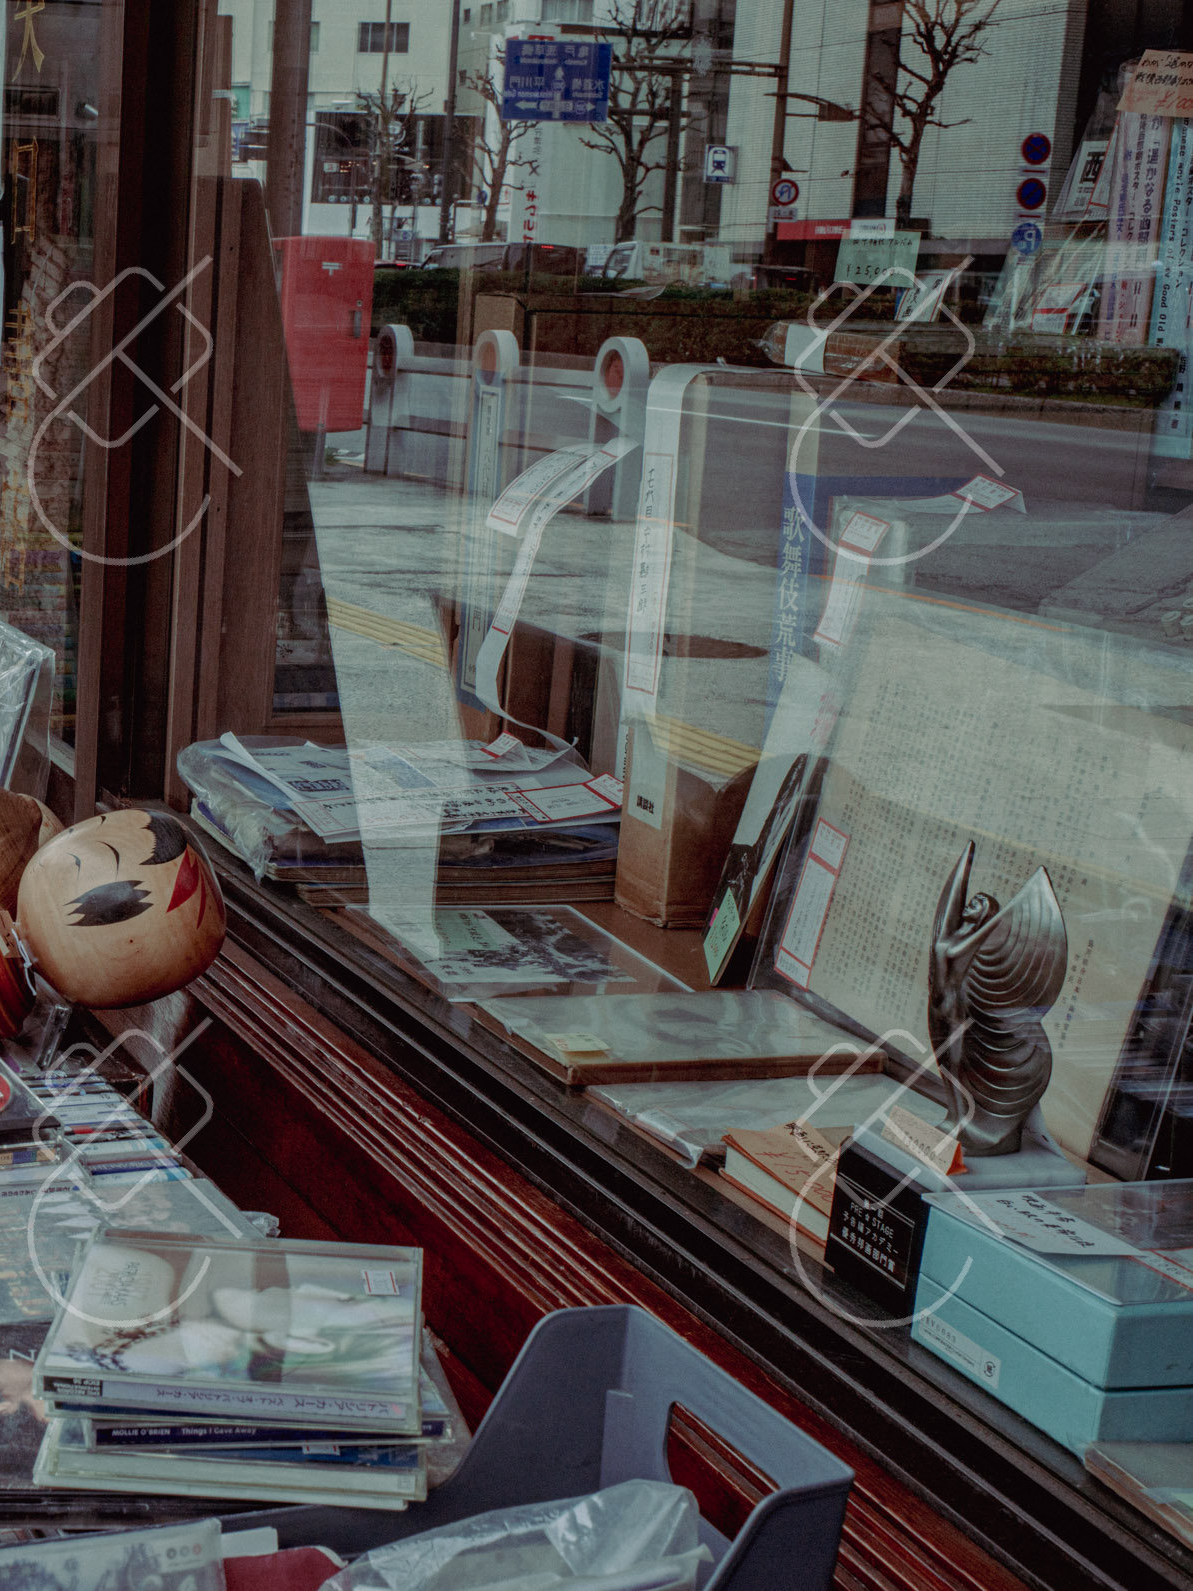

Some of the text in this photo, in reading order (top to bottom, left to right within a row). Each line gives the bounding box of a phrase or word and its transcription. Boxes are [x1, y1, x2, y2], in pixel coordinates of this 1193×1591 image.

[850, 1202, 894, 1239] PRE STAGE
[182, 1427, 207, 1436] Things
[235, 1427, 257, 1435] Away
